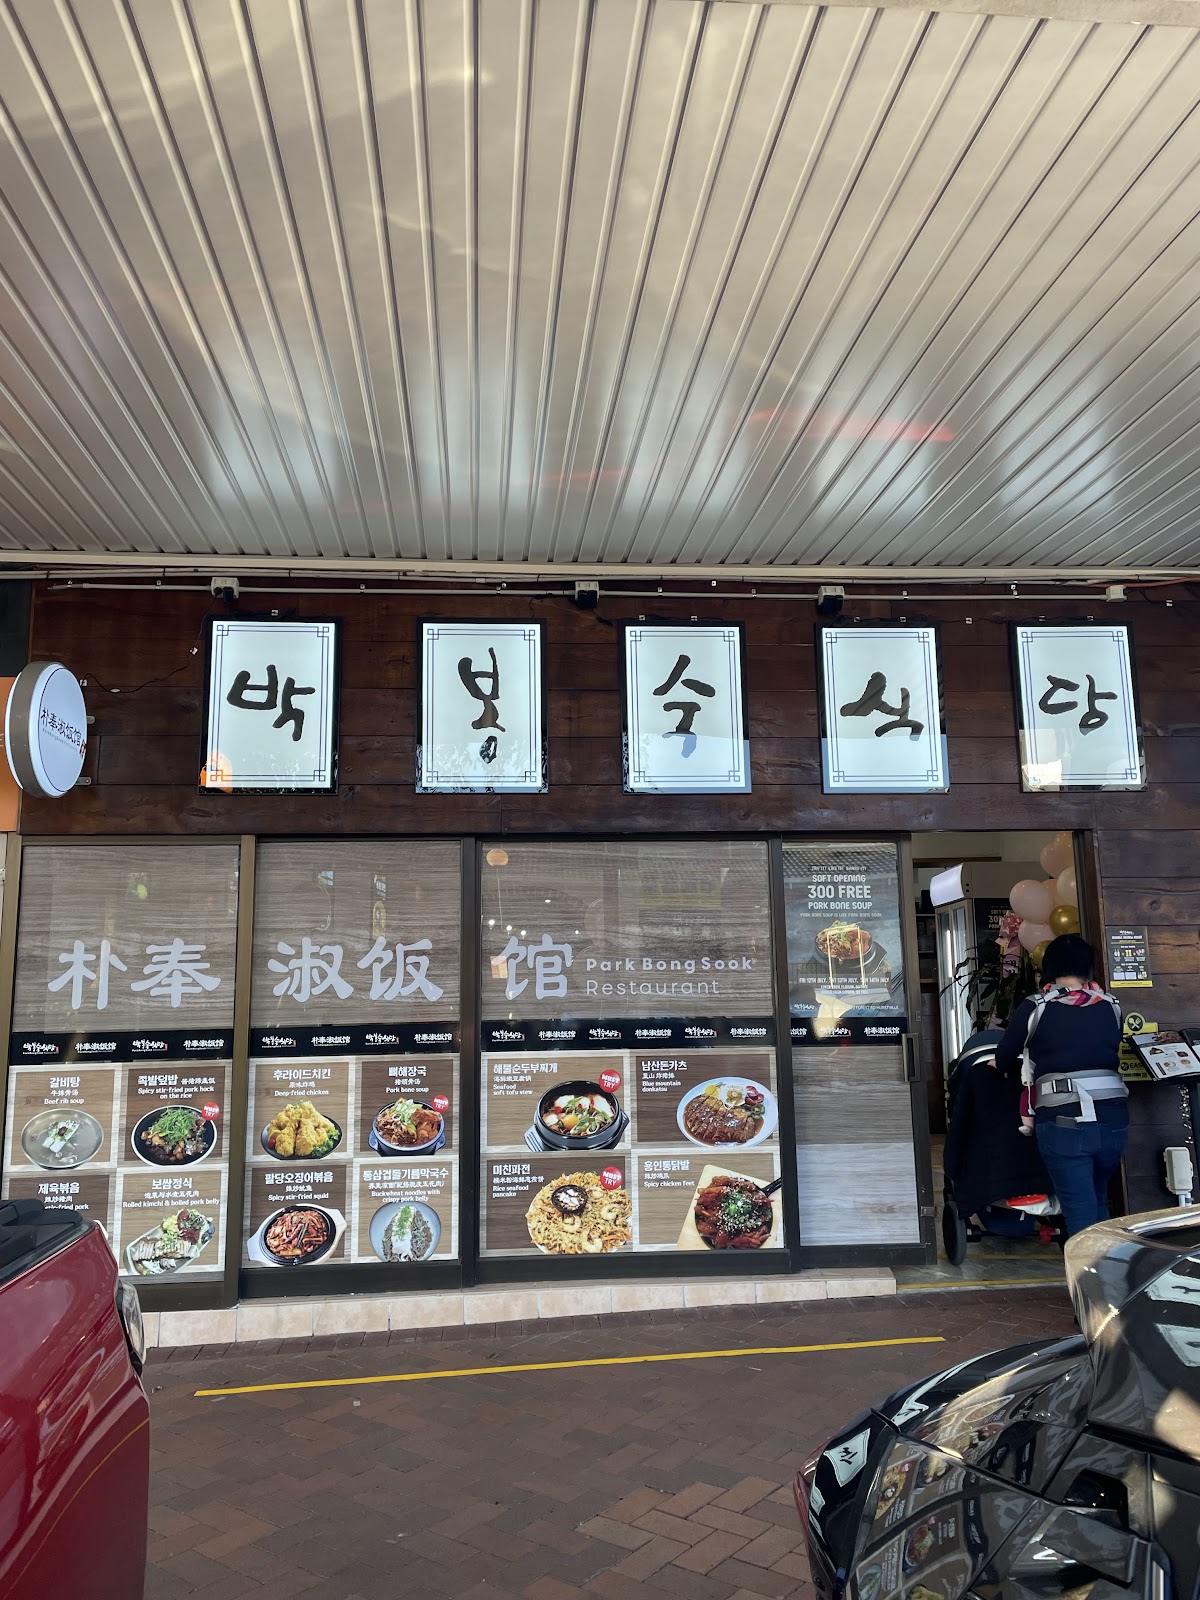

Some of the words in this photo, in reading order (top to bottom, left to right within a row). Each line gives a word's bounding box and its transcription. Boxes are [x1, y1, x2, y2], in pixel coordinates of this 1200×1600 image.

[227, 664, 315, 742] 박
[457, 647, 506, 763] 봉
[840, 671, 925, 741] 식
[1038, 674, 1118, 736] 당
[808, 885, 834, 898] 300
[838, 885, 871, 898] FREE
[808, 902, 828, 910] PORK
[830, 902, 850, 910] BONE
[852, 902, 873, 910] SOUP
[586, 958, 636, 972] Park
[642, 957, 696, 974] Bong
[702, 956, 752, 970] Sook
[586, 979, 719, 996] Restaurant
[388, 1066, 427, 1077] 뼈해장국
[493, 1063, 558, 1074] 해물순두부찌개
[642, 1060, 687, 1071] 남산돈카츠
[138, 1074, 178, 1086] 족발덮밥
[273, 1068, 331, 1080] 후라이드치킨
[601, 1074, 620, 1083] MUST
[50, 1076, 80, 1088] 갈비탕
[493, 1164, 530, 1175] 미친파전
[644, 1160, 690, 1171] 용인통닭발
[265, 1171, 333, 1184] 팔당오징어볶음
[363, 1168, 449, 1181] 통삼겹들기름막국수
[602, 1171, 621, 1180] MUST
[38, 1182, 80, 1194] 제육볶음
[152, 1178, 192, 1190] 보쌈정식
[604, 1178, 617, 1186] TRY
[75, 1203, 89, 1211] pork
